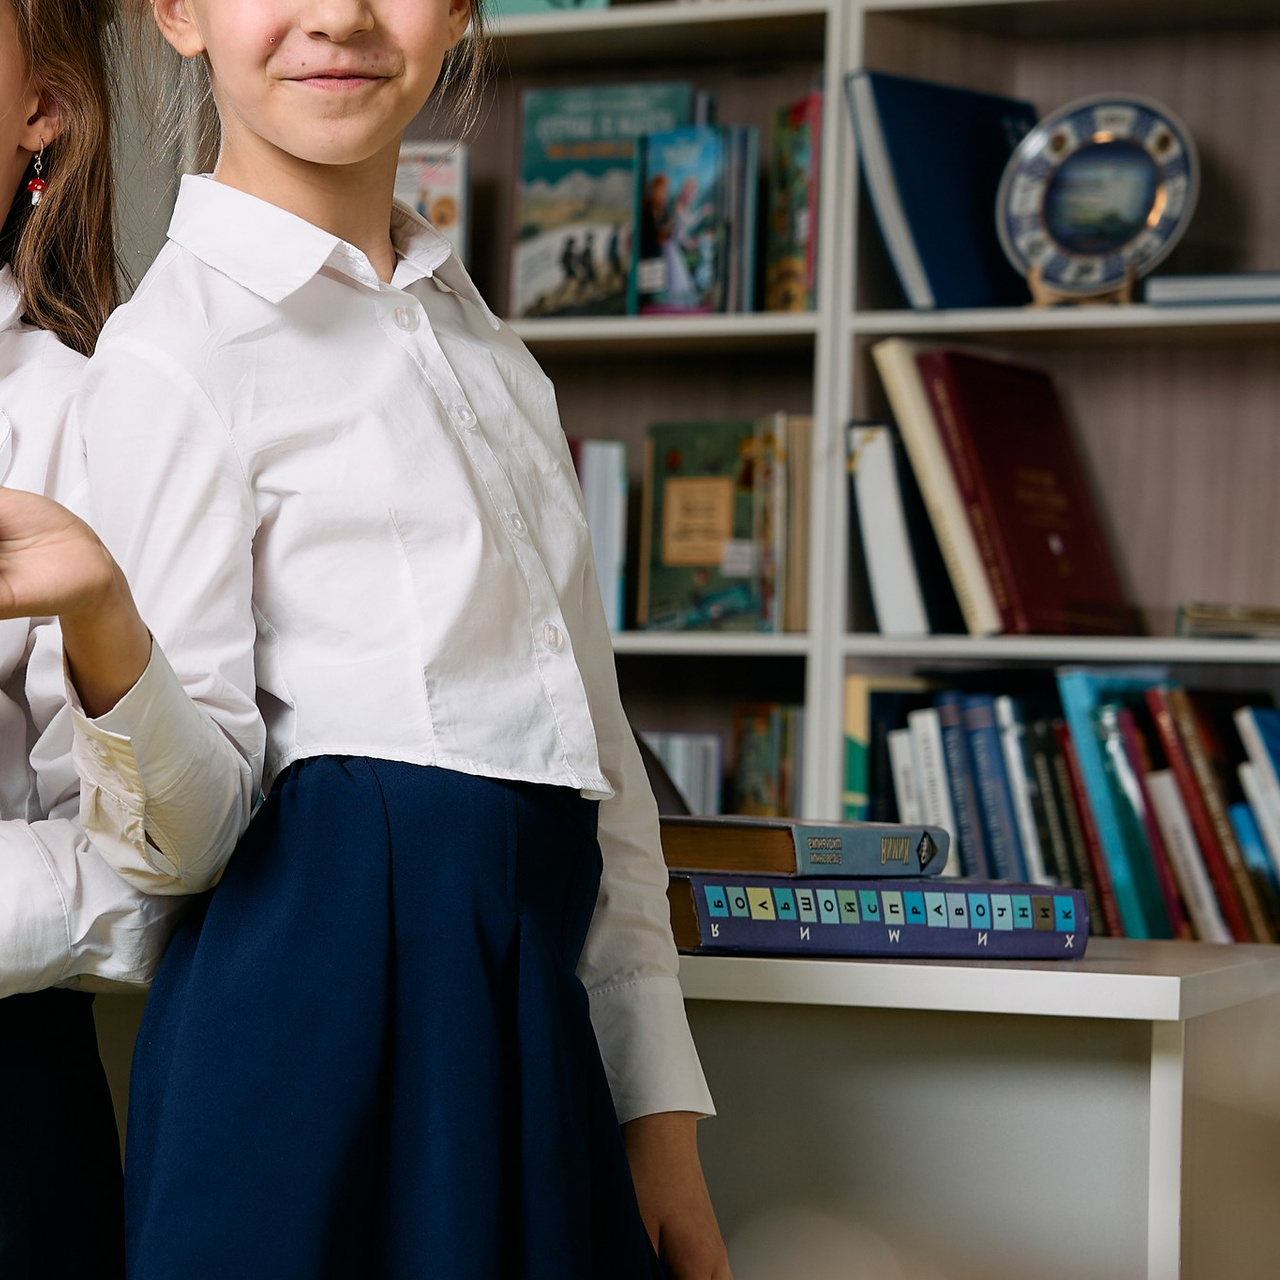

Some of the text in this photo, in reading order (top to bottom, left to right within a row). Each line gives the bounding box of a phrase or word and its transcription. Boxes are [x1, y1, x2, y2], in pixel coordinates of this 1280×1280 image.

[710, 894, 1075, 922] БОЛЬШОЙ СПРАВОЧНИК
[710, 923, 1075, 949] ХИМИЯ
